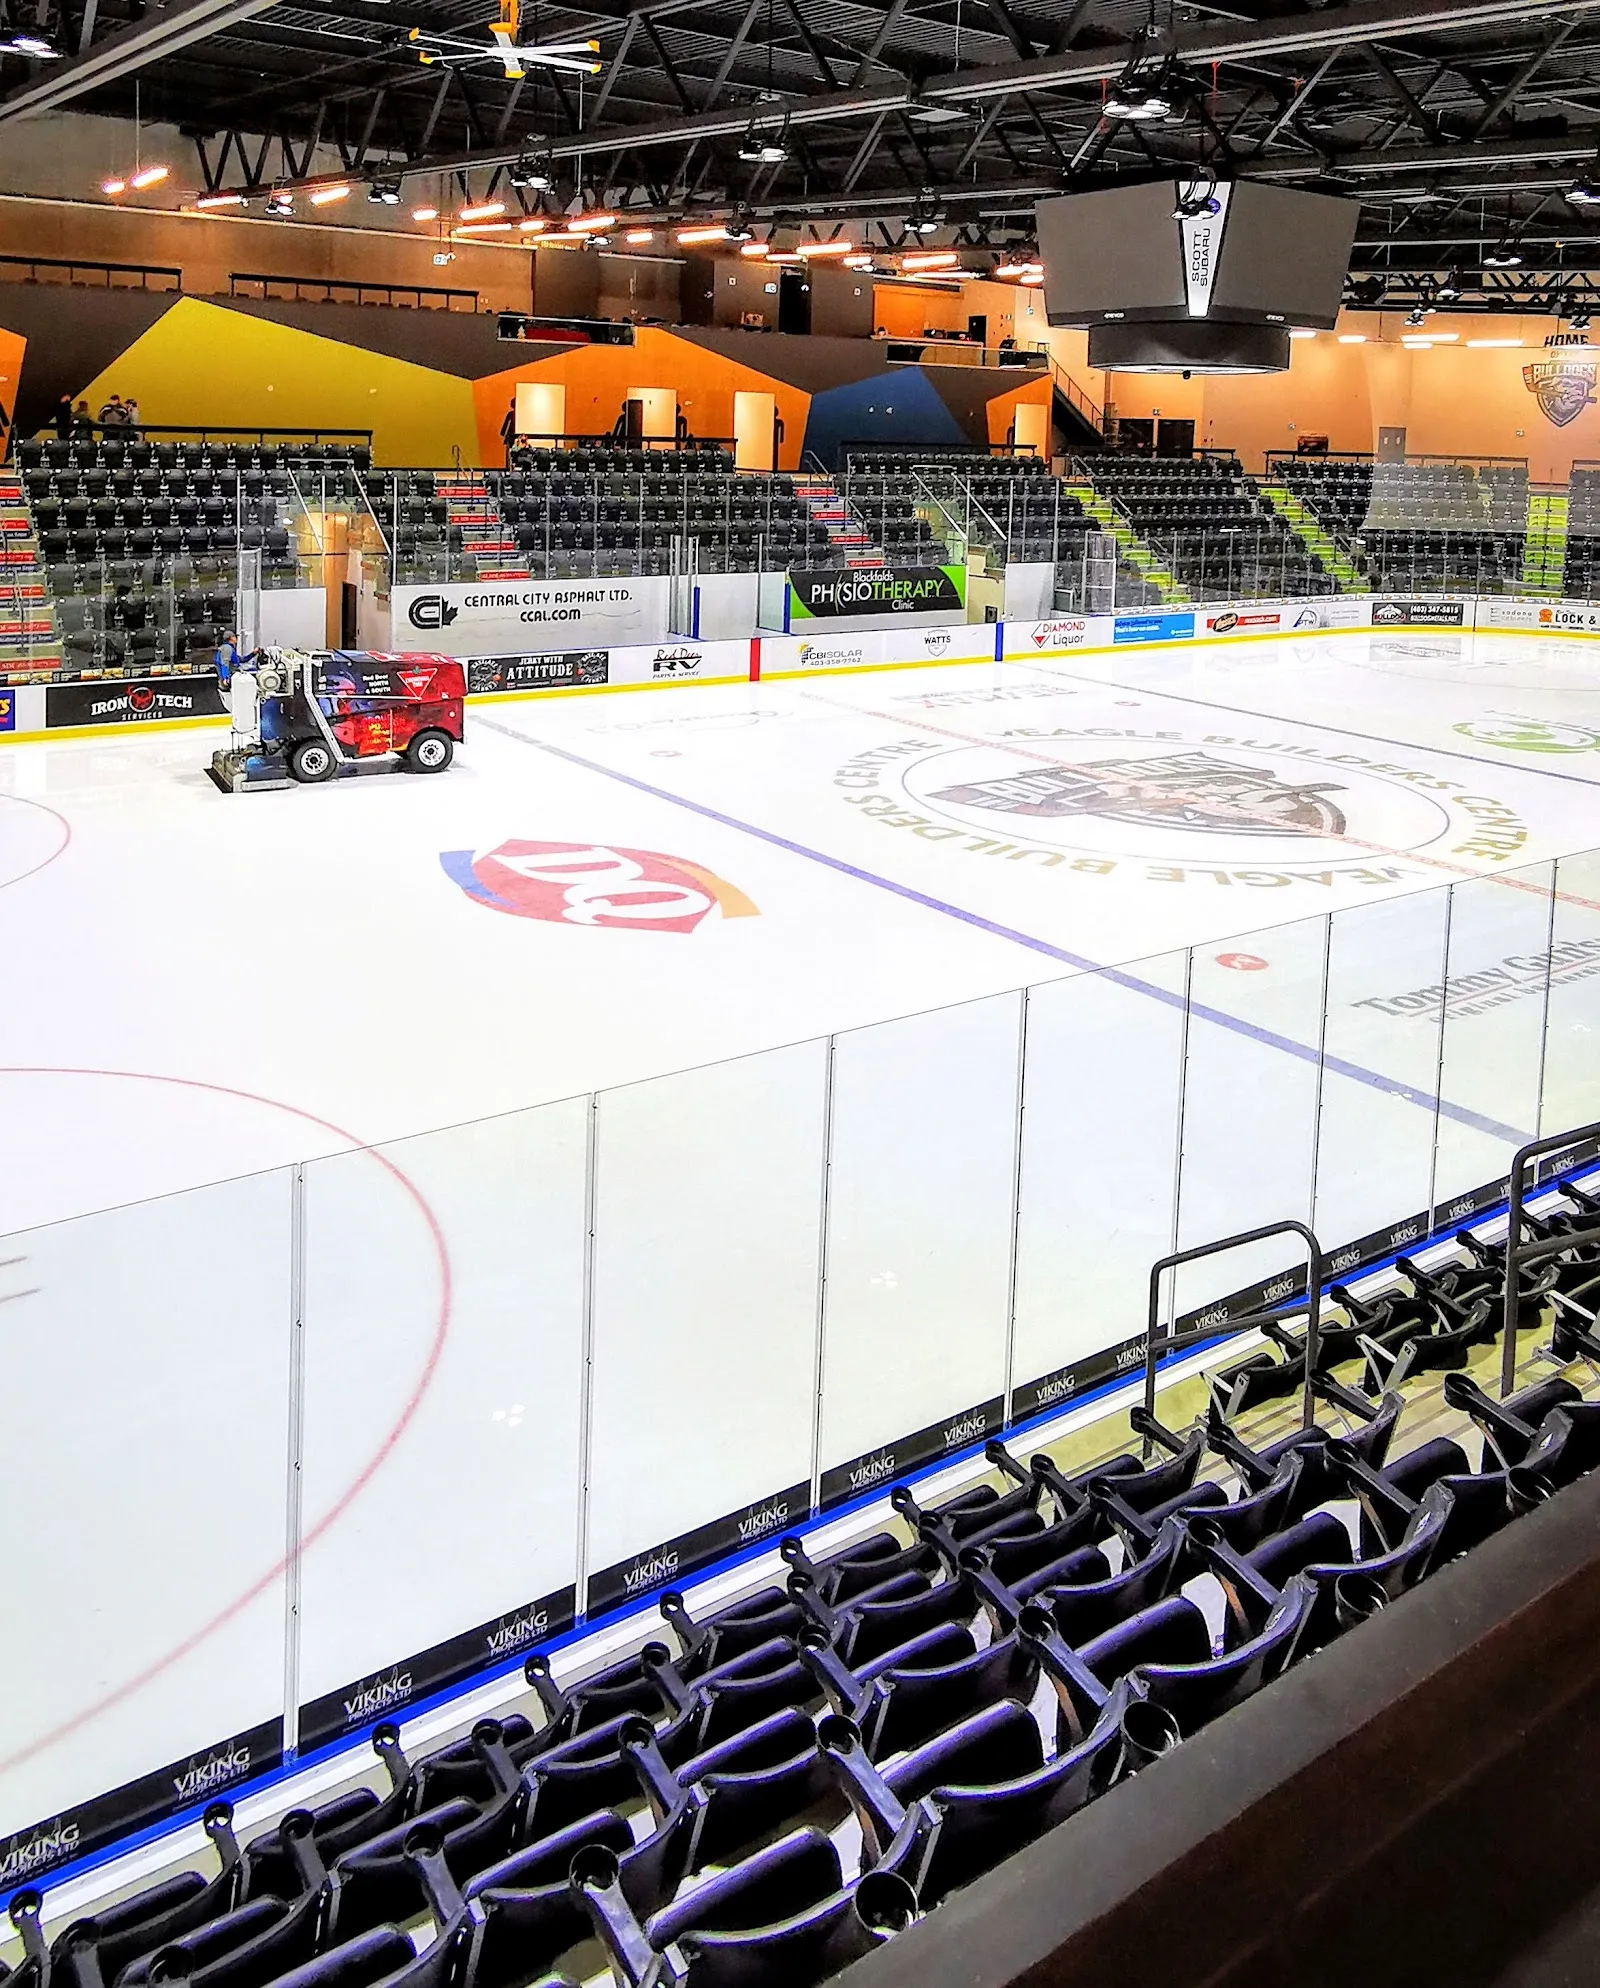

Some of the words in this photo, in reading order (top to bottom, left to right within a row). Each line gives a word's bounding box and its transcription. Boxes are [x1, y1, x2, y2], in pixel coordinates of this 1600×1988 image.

[1192, 231, 1202, 282] SCOTT
[1200, 228, 1210, 286] SUBARU
[1544, 333, 1589, 348] HOME
[853, 570, 895, 583] Blackfalds
[464, 594, 520, 608] CENTRAL
[522, 592, 550, 606] CITY
[554, 590, 607, 605] ASPHALT
[609, 588, 633, 602] LTD.
[811, 578, 946, 609] PHYSIOTHERAPY
[520, 608, 582, 624] CCAL.COM
[892, 599, 915, 611] Clinic
[1043, 621, 1086, 633] DIAMOND
[1555, 614, 1584, 624] LOCK
[1588, 616, 1597, 625] &
[924, 635, 952, 646] WATTS
[1052, 633, 1085, 648] Liquor
[657, 648, 678, 660] Red
[507, 664, 574, 681] ATTITUDE
[653, 660, 701, 672] RV
[91, 696, 128, 716] IRON
[156, 694, 193, 708] TECH
[122, 712, 163, 721] SERVICES
[833, 738, 943, 789] CENTRE
[1203, 735, 1466, 791] BUILDERS
[1452, 796, 1529, 862] CENTRE
[842, 793, 1119, 876] BUILDERS
[1351, 967, 1522, 1016] Tommy
[1390, 1224, 1418, 1244] VIKING
[1331, 1250, 1360, 1269] VIKING
[1263, 1278, 1294, 1299] VIKING
[1195, 1307, 1228, 1329] VIKING
[1036, 1374, 1074, 1400] VIKING
[944, 1415, 986, 1441] VIKING
[850, 1455, 895, 1484] VIKING
[738, 1502, 788, 1534] VIKING
[624, 1551, 678, 1586] VIKING
[486, 1611, 548, 1650] VIKING
[344, 1672, 412, 1714] VIKING
[173, 1747, 250, 1792] VIKING
[0, 1822, 80, 1875] VIKING
